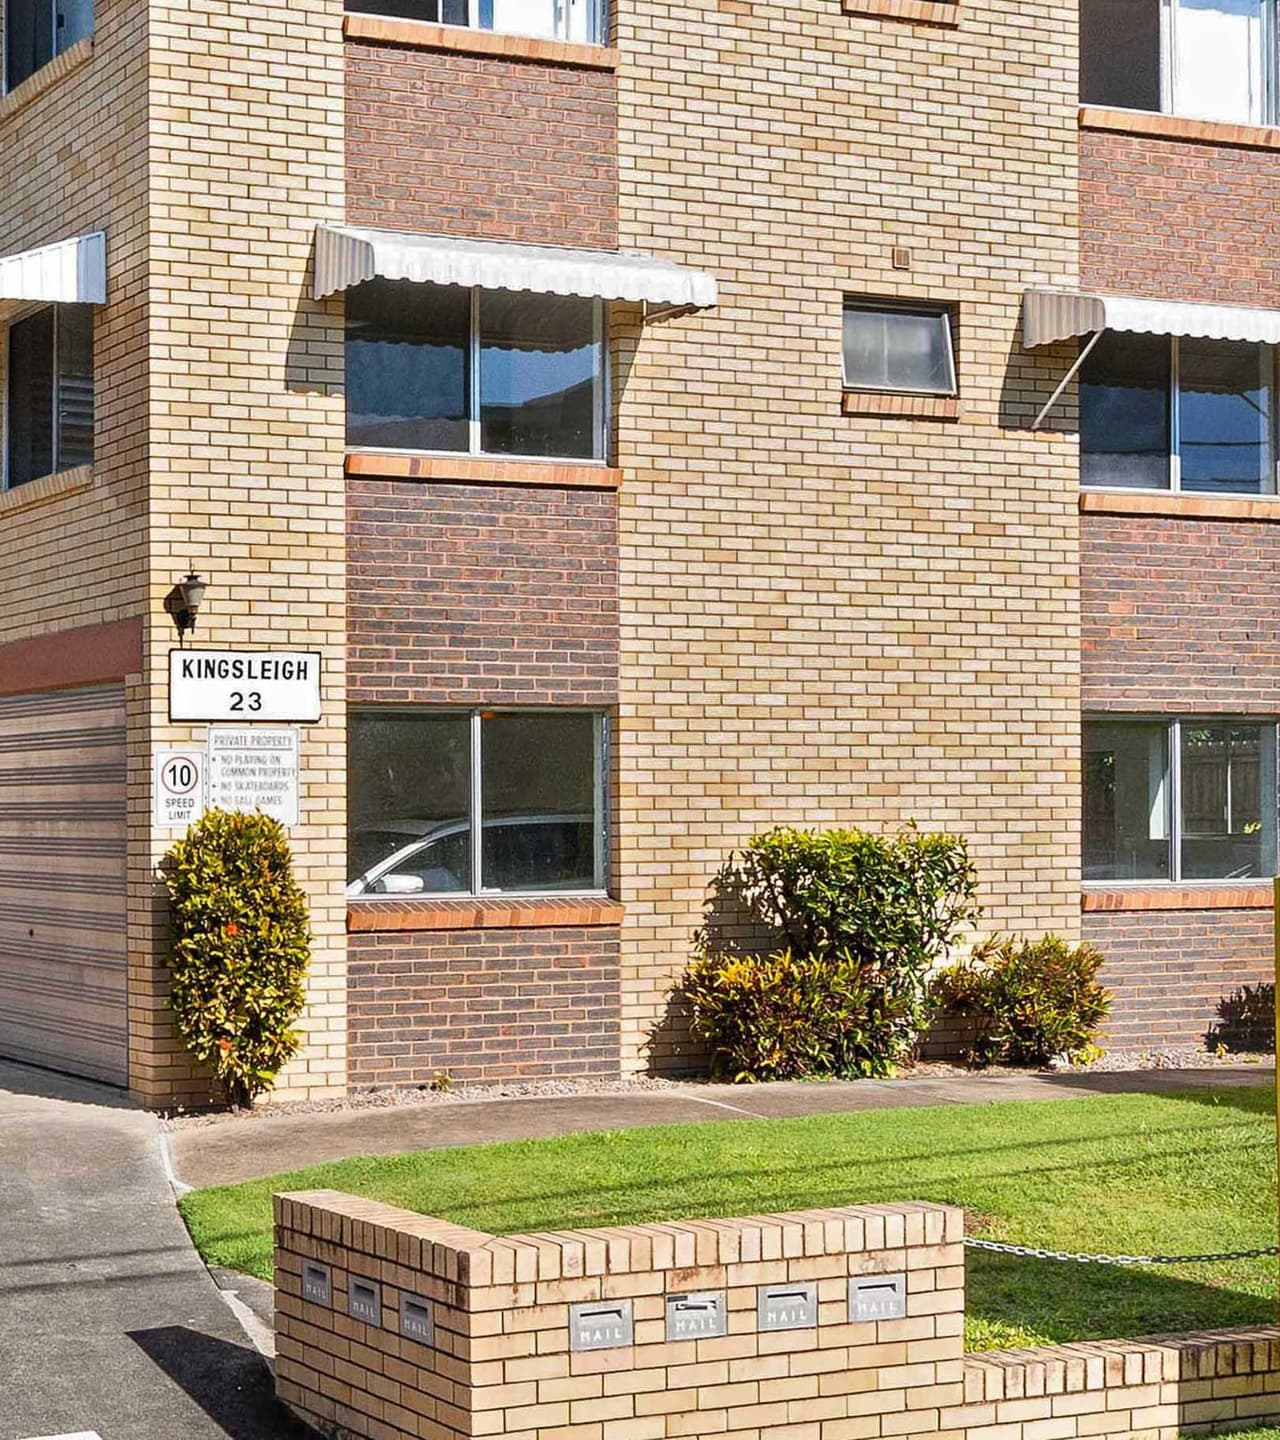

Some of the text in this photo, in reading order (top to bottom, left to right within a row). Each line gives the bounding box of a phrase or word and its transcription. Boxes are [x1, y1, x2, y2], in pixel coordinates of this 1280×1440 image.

[181, 658, 308, 681] KINGSLEIGH
[229, 692, 263, 712] 23
[214, 735, 292, 747] PRIVATE PROPERTY
[168, 764, 192, 787] 10
[221, 767, 256, 777] COMMON
[165, 798, 195, 809] SPEED
[168, 810, 192, 821] LIMIT
[305, 1284, 327, 1300] MAIL
[352, 1302, 376, 1318] MAIL
[856, 1301, 898, 1314] MAIL
[767, 1310, 808, 1323] MAIL
[404, 1319, 429, 1337] MAIL
[676, 1318, 717, 1332] MAIL
[580, 1327, 623, 1343] MAIL
